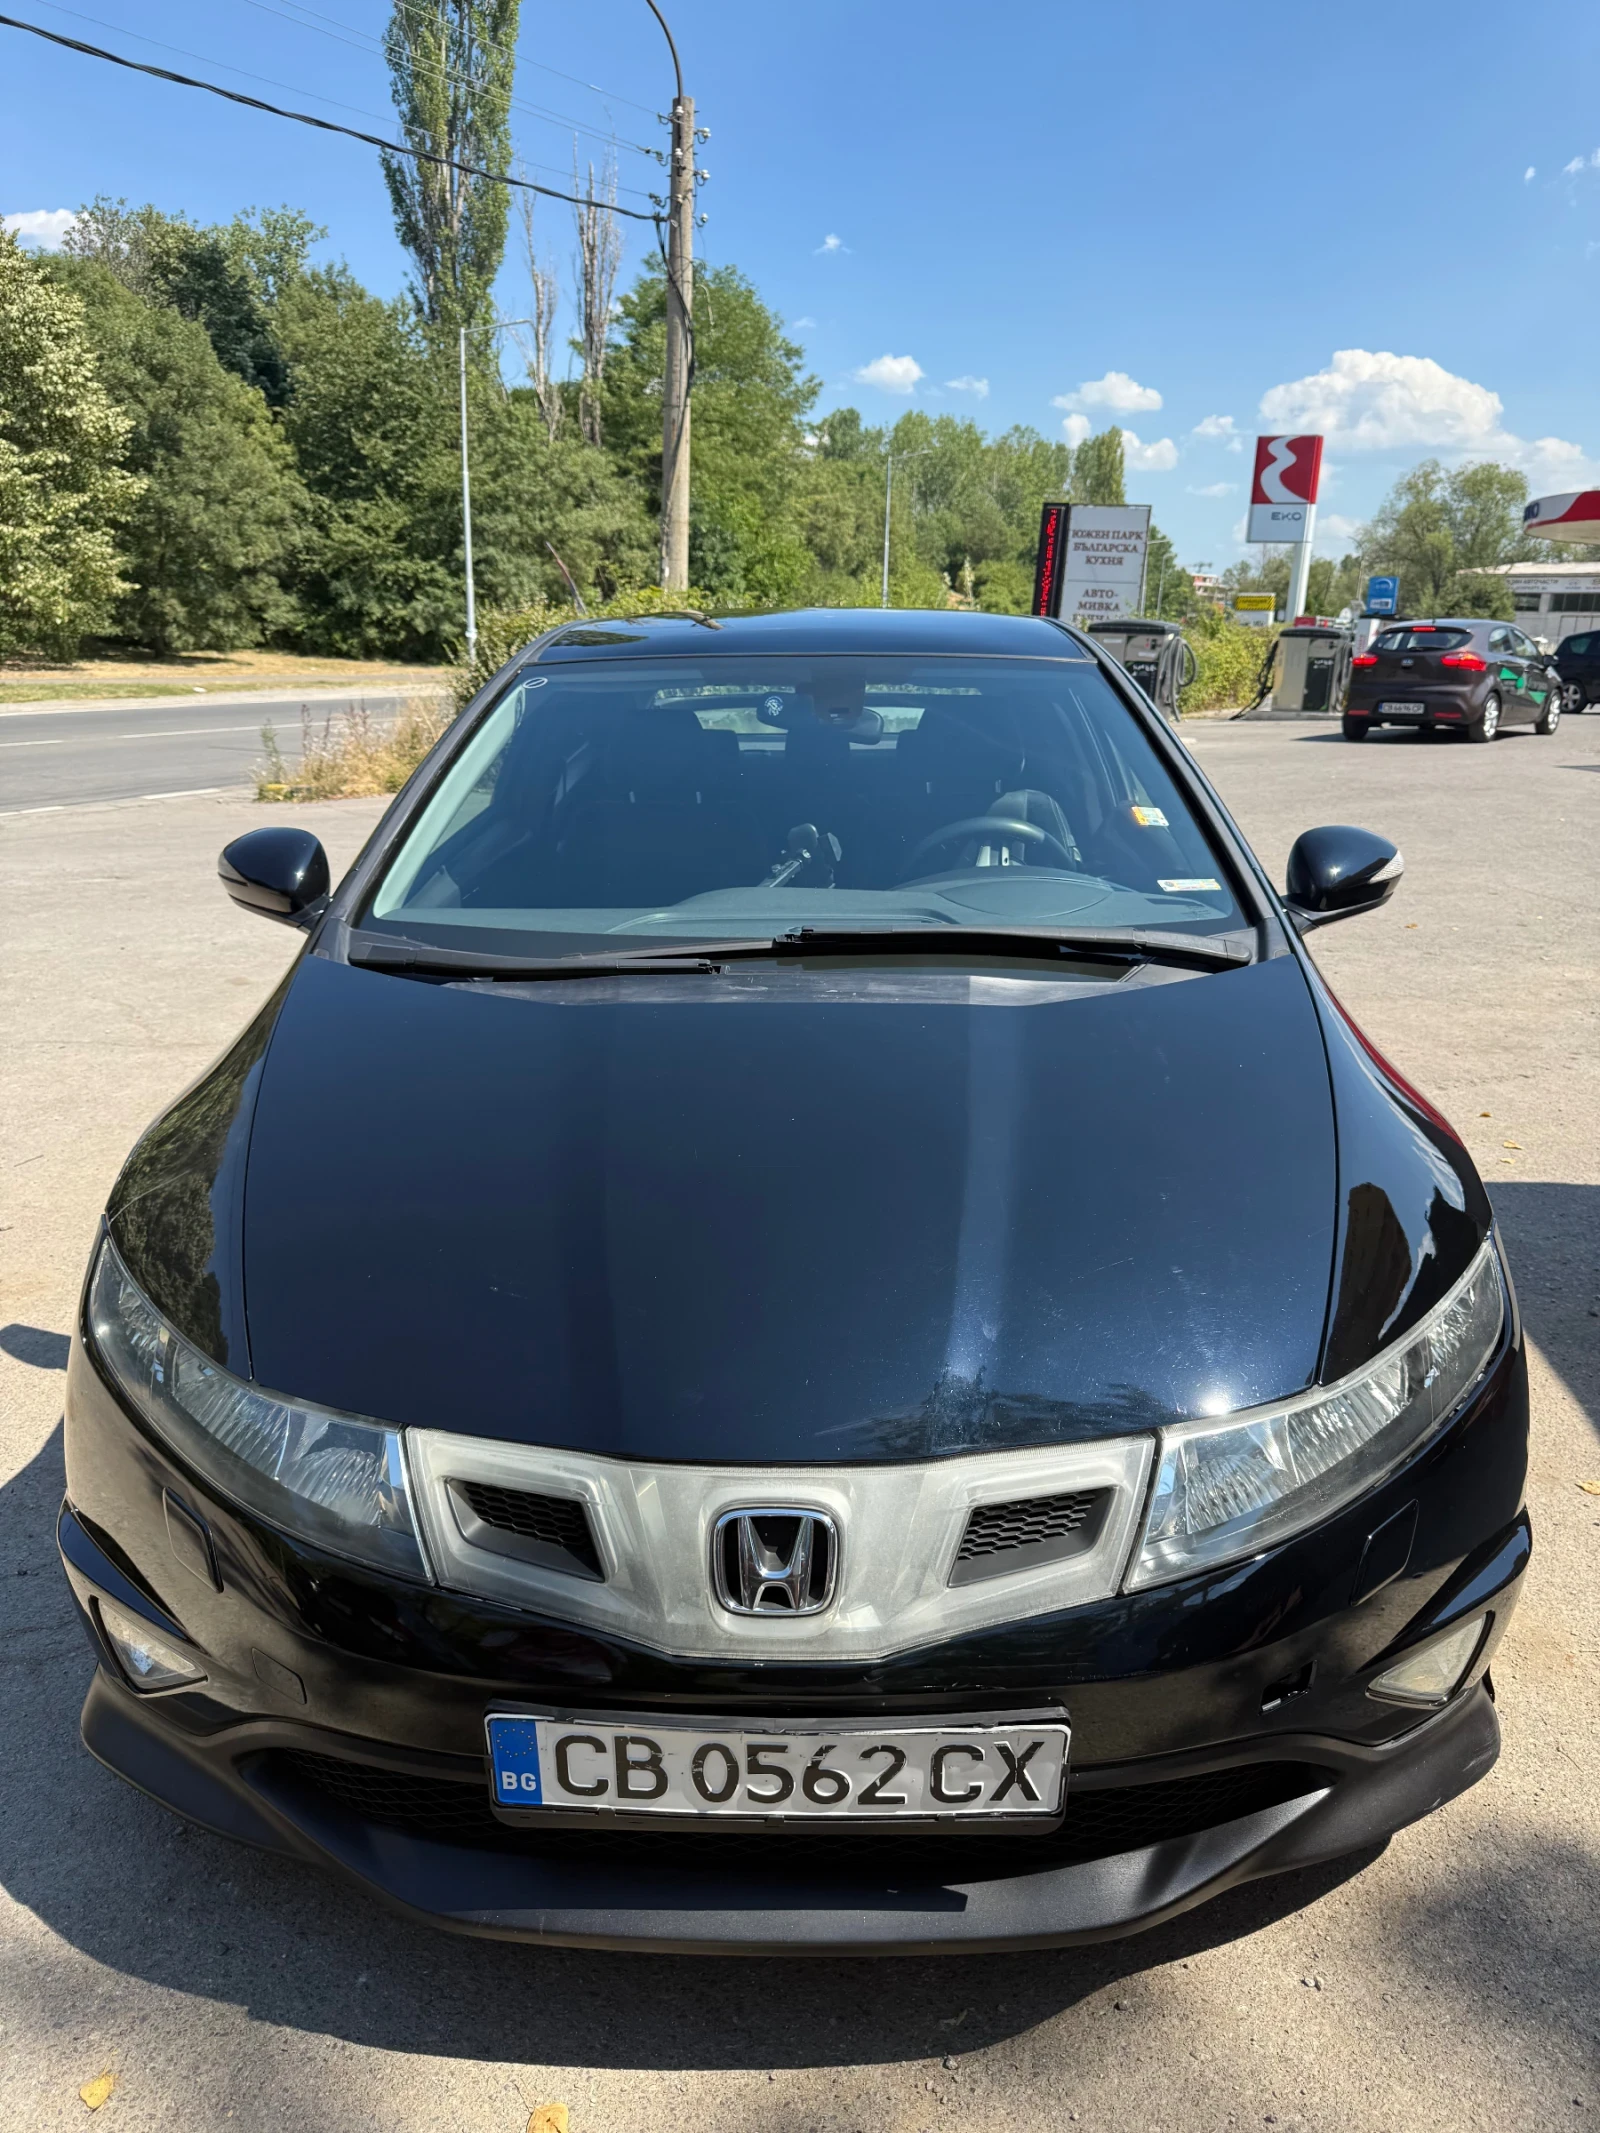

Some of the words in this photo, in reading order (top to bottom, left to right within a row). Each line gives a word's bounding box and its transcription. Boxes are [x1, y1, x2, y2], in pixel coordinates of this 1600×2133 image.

[1271, 511, 1302, 521] EKO
[1072, 529, 1110, 540] ЮЖЕН
[1112, 530, 1144, 540] ПАРК
[1073, 542, 1138, 553] БЪЛГАРСКА
[1085, 555, 1124, 566] КУХНЯ
[1083, 588, 1118, 598] АВТО-
[1077, 600, 1120, 611] МИВКА
[555, 1735, 669, 1799] CB
[691, 1742, 907, 1804] 0562
[930, 1740, 1044, 1803] CX
[501, 1771, 537, 1792] BG
